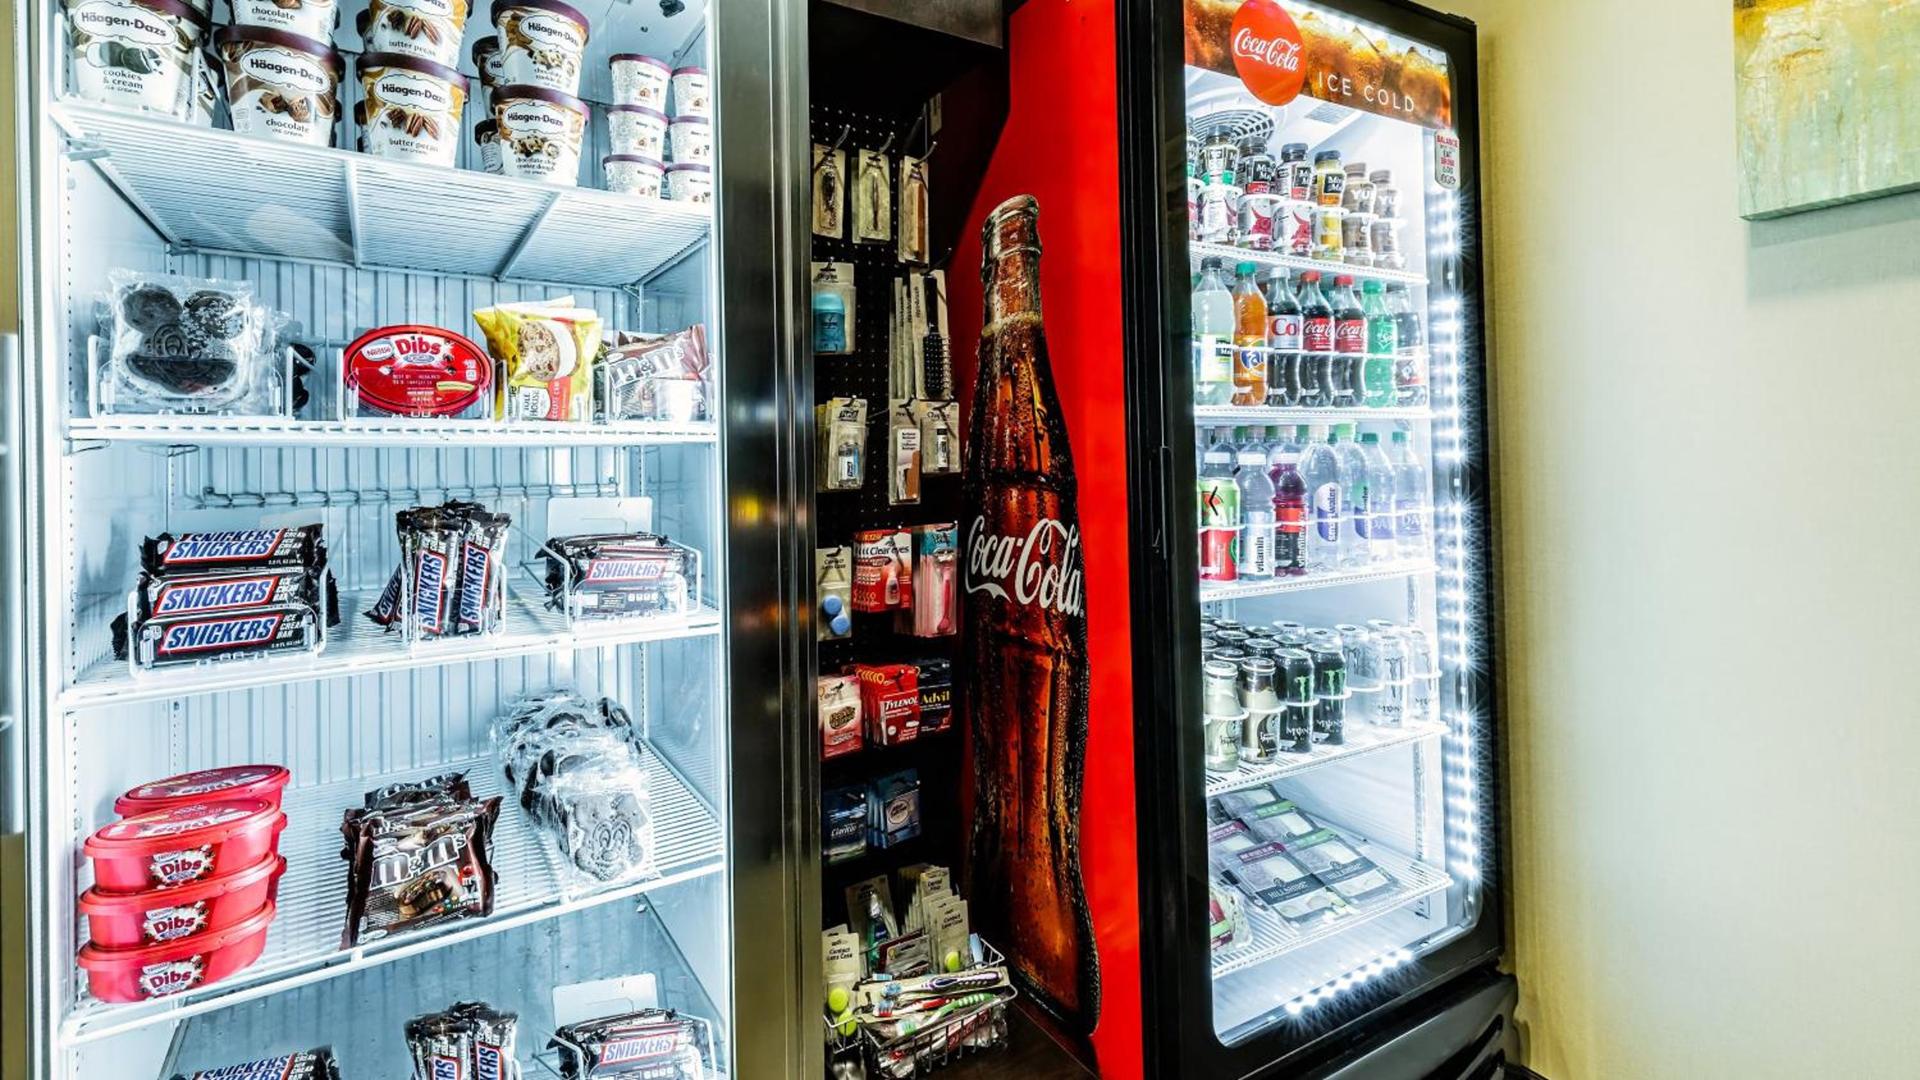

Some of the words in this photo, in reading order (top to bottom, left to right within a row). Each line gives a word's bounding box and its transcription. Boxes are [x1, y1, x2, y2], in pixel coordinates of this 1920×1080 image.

[251, 6, 295, 21] chocolate
[81, 11, 167, 38] Häagen-Dazs
[1234, 27, 1298, 72] Coca-Cola
[103, 68, 142, 81] cookies
[250, 58, 324, 86] Häagen-Dazs
[112, 79, 144, 90] cream
[382, 82, 446, 104] Häagen-Dazs
[1318, 72, 1352, 96] ICE
[1364, 85, 1415, 113] COLD
[266, 118, 310, 133] chocolate
[395, 336, 441, 355] Dibs
[1327, 487, 1338, 541] smatwater
[170, 540, 274, 560] SNICKERS
[870, 545, 889, 555] Clear
[591, 559, 663, 579] SNICKERS
[965, 515, 1081, 617] Coca-Cola
[417, 553, 443, 627] SNICKERS
[460, 547, 487, 619] SNICKERS
[162, 581, 271, 610] SNICKERS
[280, 622, 303, 630] CREA
[283, 614, 296, 622] ICE
[168, 618, 276, 648] SNICKERS
[276, 630, 294, 640] BAR
[921, 690, 950, 704] Advil
[160, 858, 203, 875] Dibs
[153, 915, 195, 935] Dibs
[150, 969, 192, 989] Dibs
[606, 1037, 673, 1061] SNICKERS
[202, 1056, 290, 1080] SNICKERS
